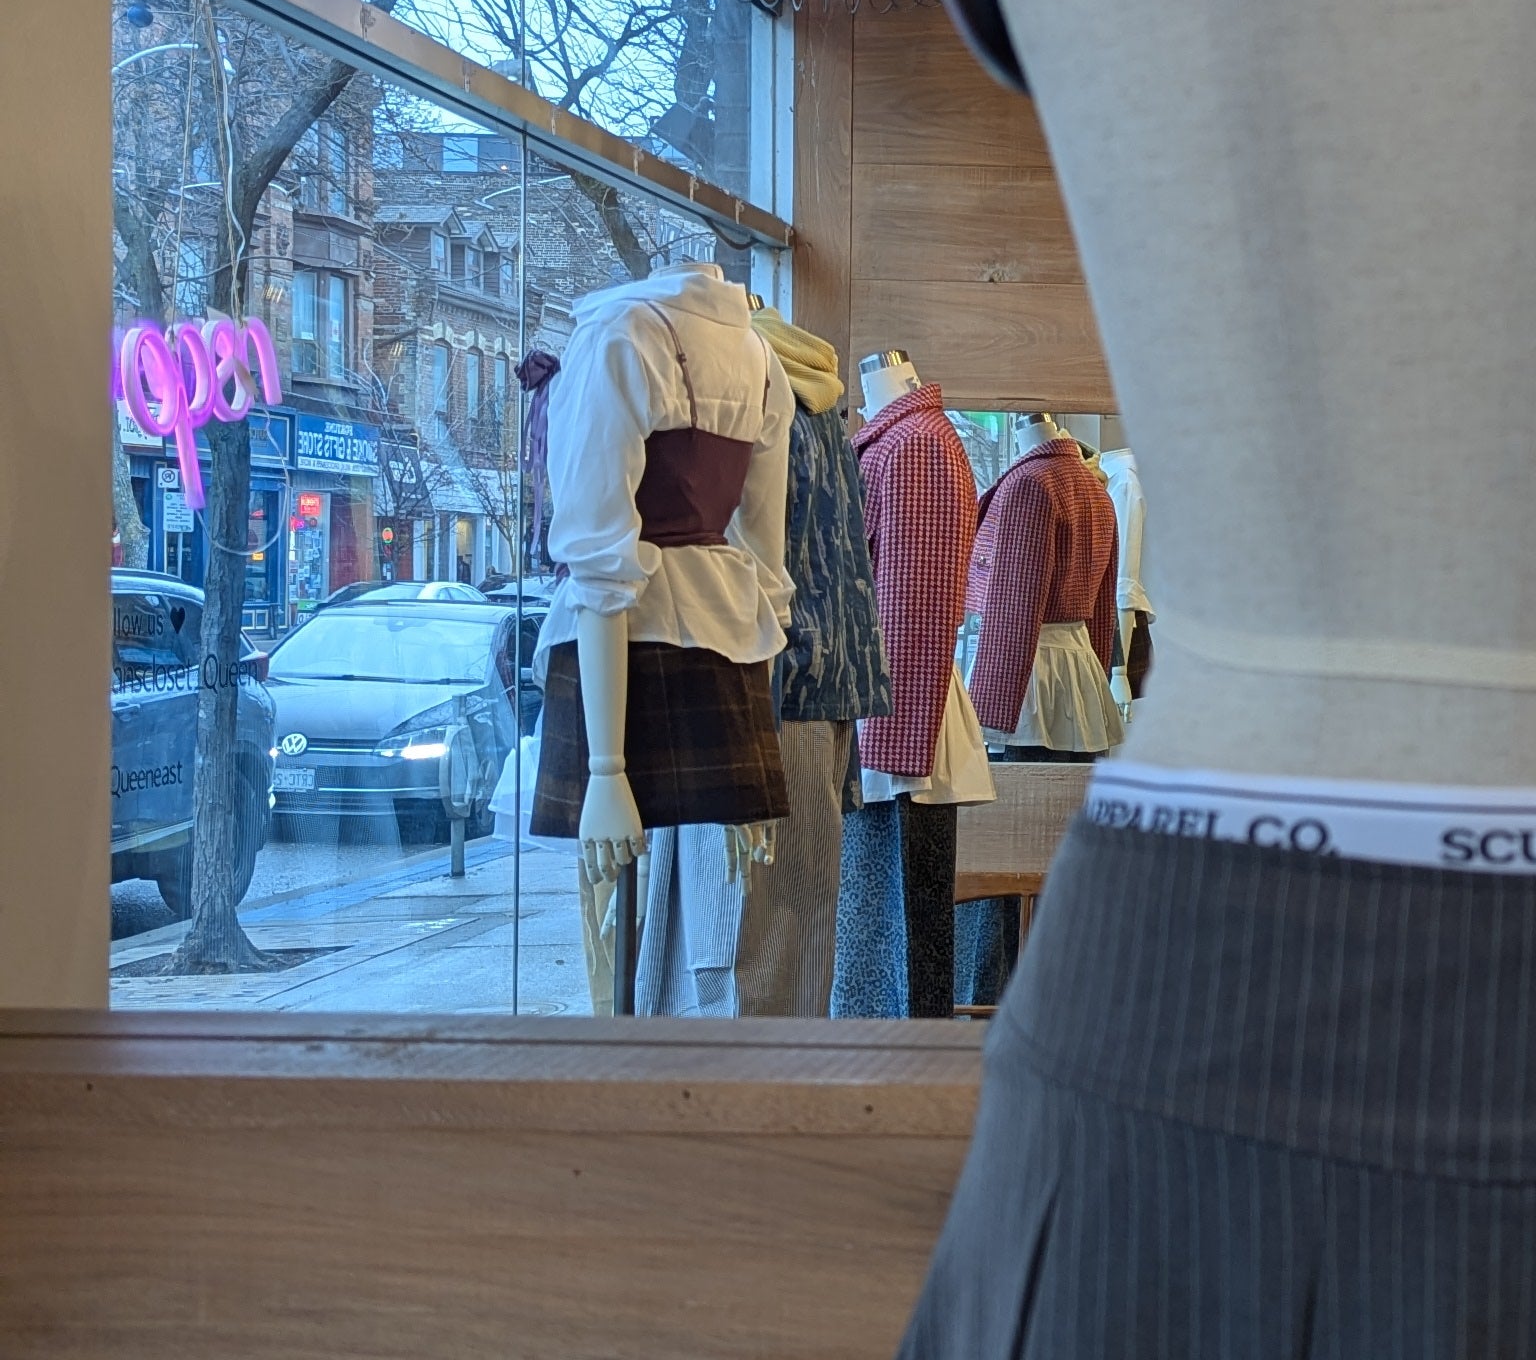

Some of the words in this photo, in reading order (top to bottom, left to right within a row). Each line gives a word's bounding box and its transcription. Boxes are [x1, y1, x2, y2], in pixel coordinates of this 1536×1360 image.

[121, 316, 283, 509] open
[147, 614, 164, 636] us
[1086, 793, 1232, 841] PPAREL
